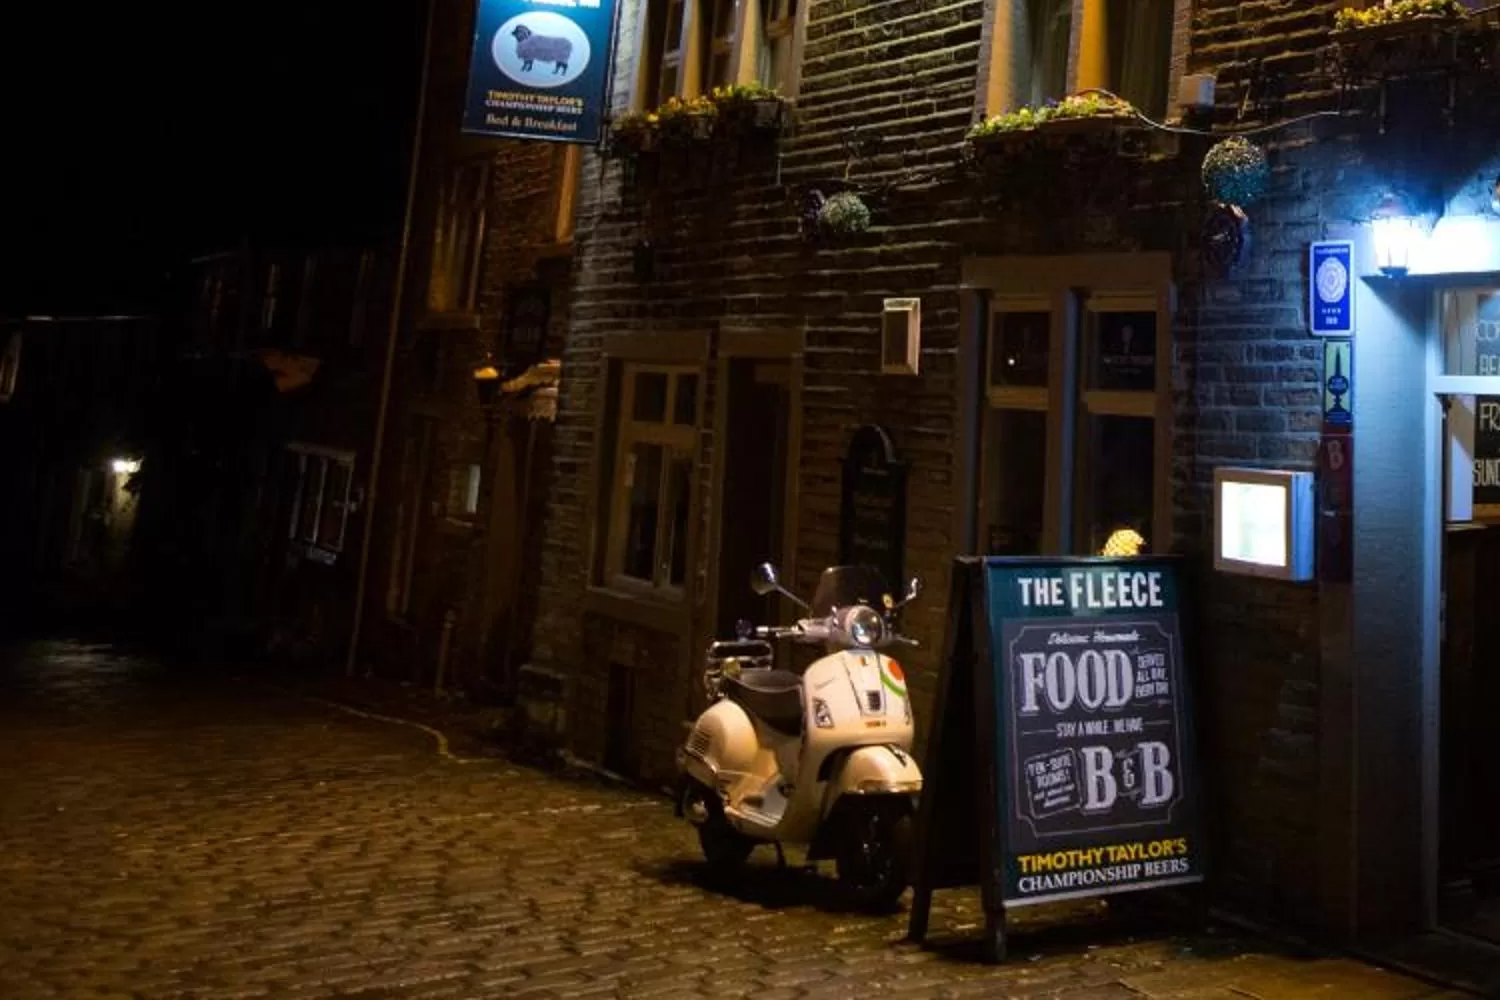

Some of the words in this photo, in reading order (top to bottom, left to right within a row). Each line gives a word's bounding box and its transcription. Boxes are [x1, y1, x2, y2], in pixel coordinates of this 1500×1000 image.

[1018, 577, 1064, 606] THE
[1071, 571, 1163, 608] FLEECE
[1019, 648, 1135, 714] FOOD
[1056, 721, 1077, 738] STAY
[1017, 846, 1105, 873] TIMOTHY
[1105, 836, 1188, 863] TAYLOR'S
[1018, 862, 1141, 893] CHAMPIONSHIP
[1144, 857, 1190, 878] BEERS
